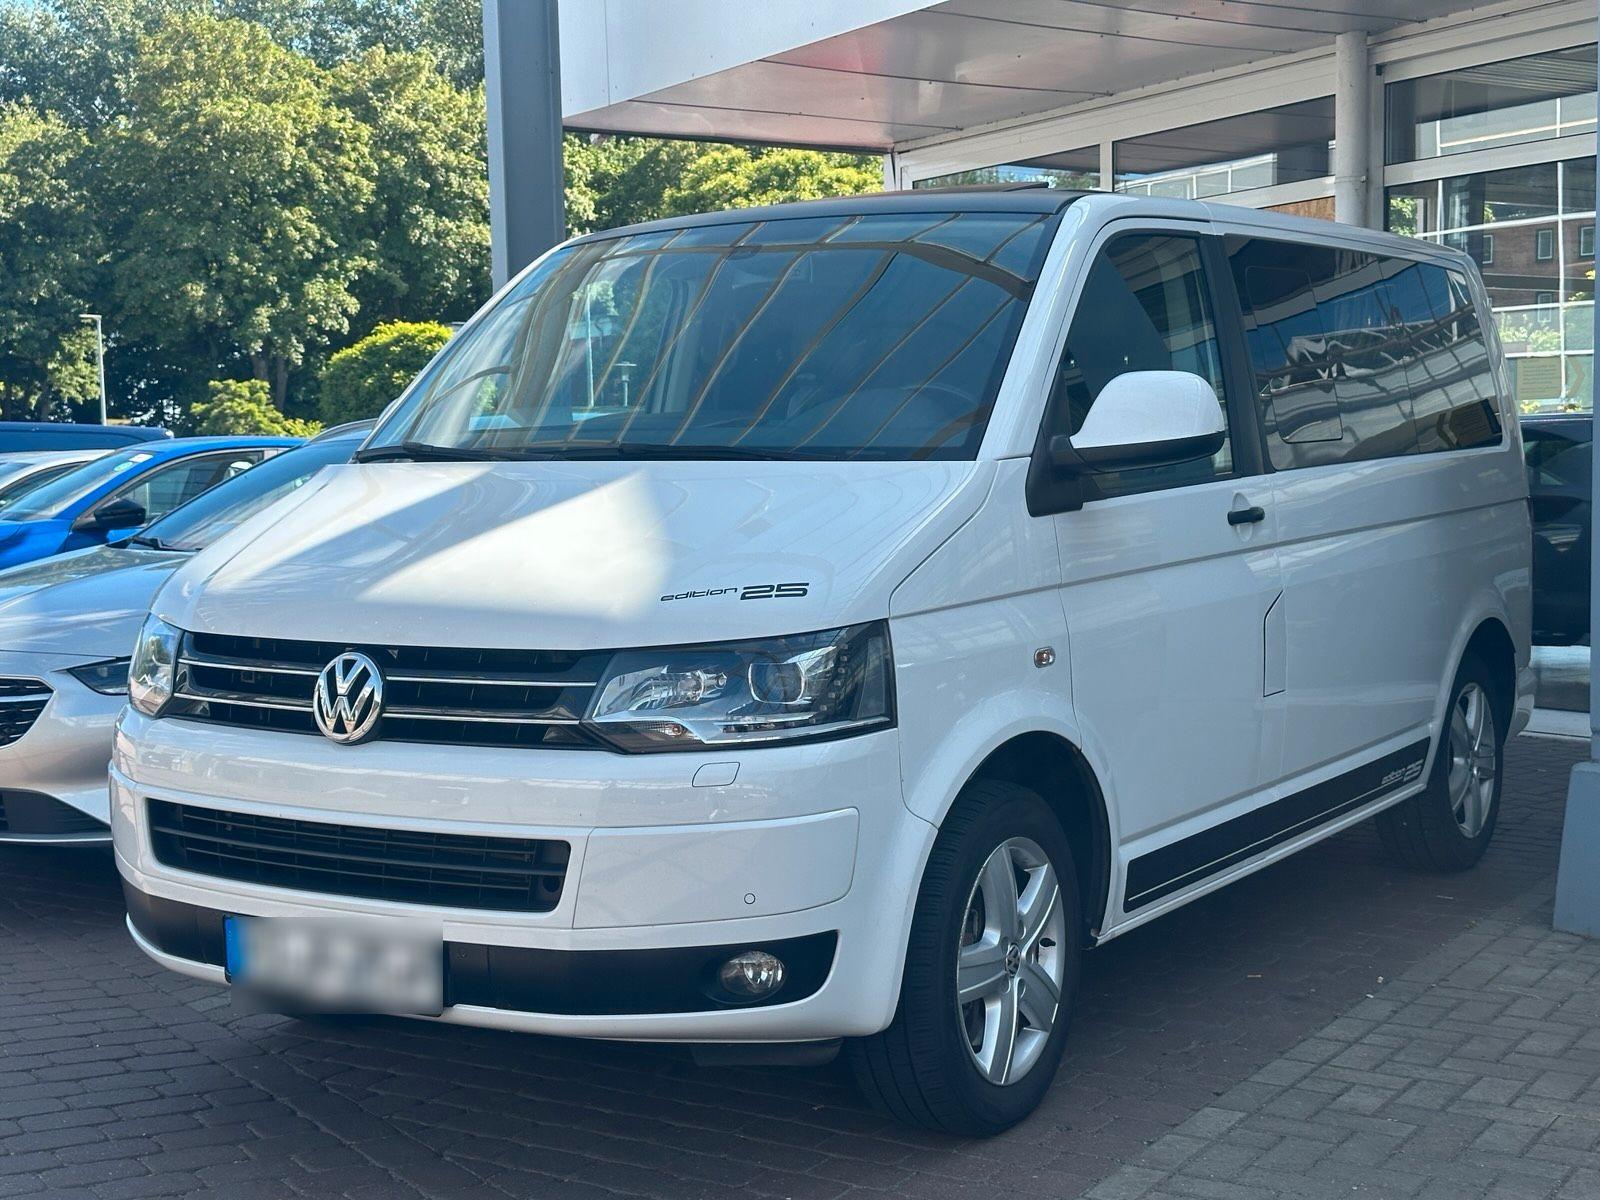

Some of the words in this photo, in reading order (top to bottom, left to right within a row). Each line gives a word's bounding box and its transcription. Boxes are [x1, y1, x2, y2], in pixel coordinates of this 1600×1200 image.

[660, 587, 738, 602] edition
[739, 582, 810, 601] 25
[313, 652, 382, 742] VW
